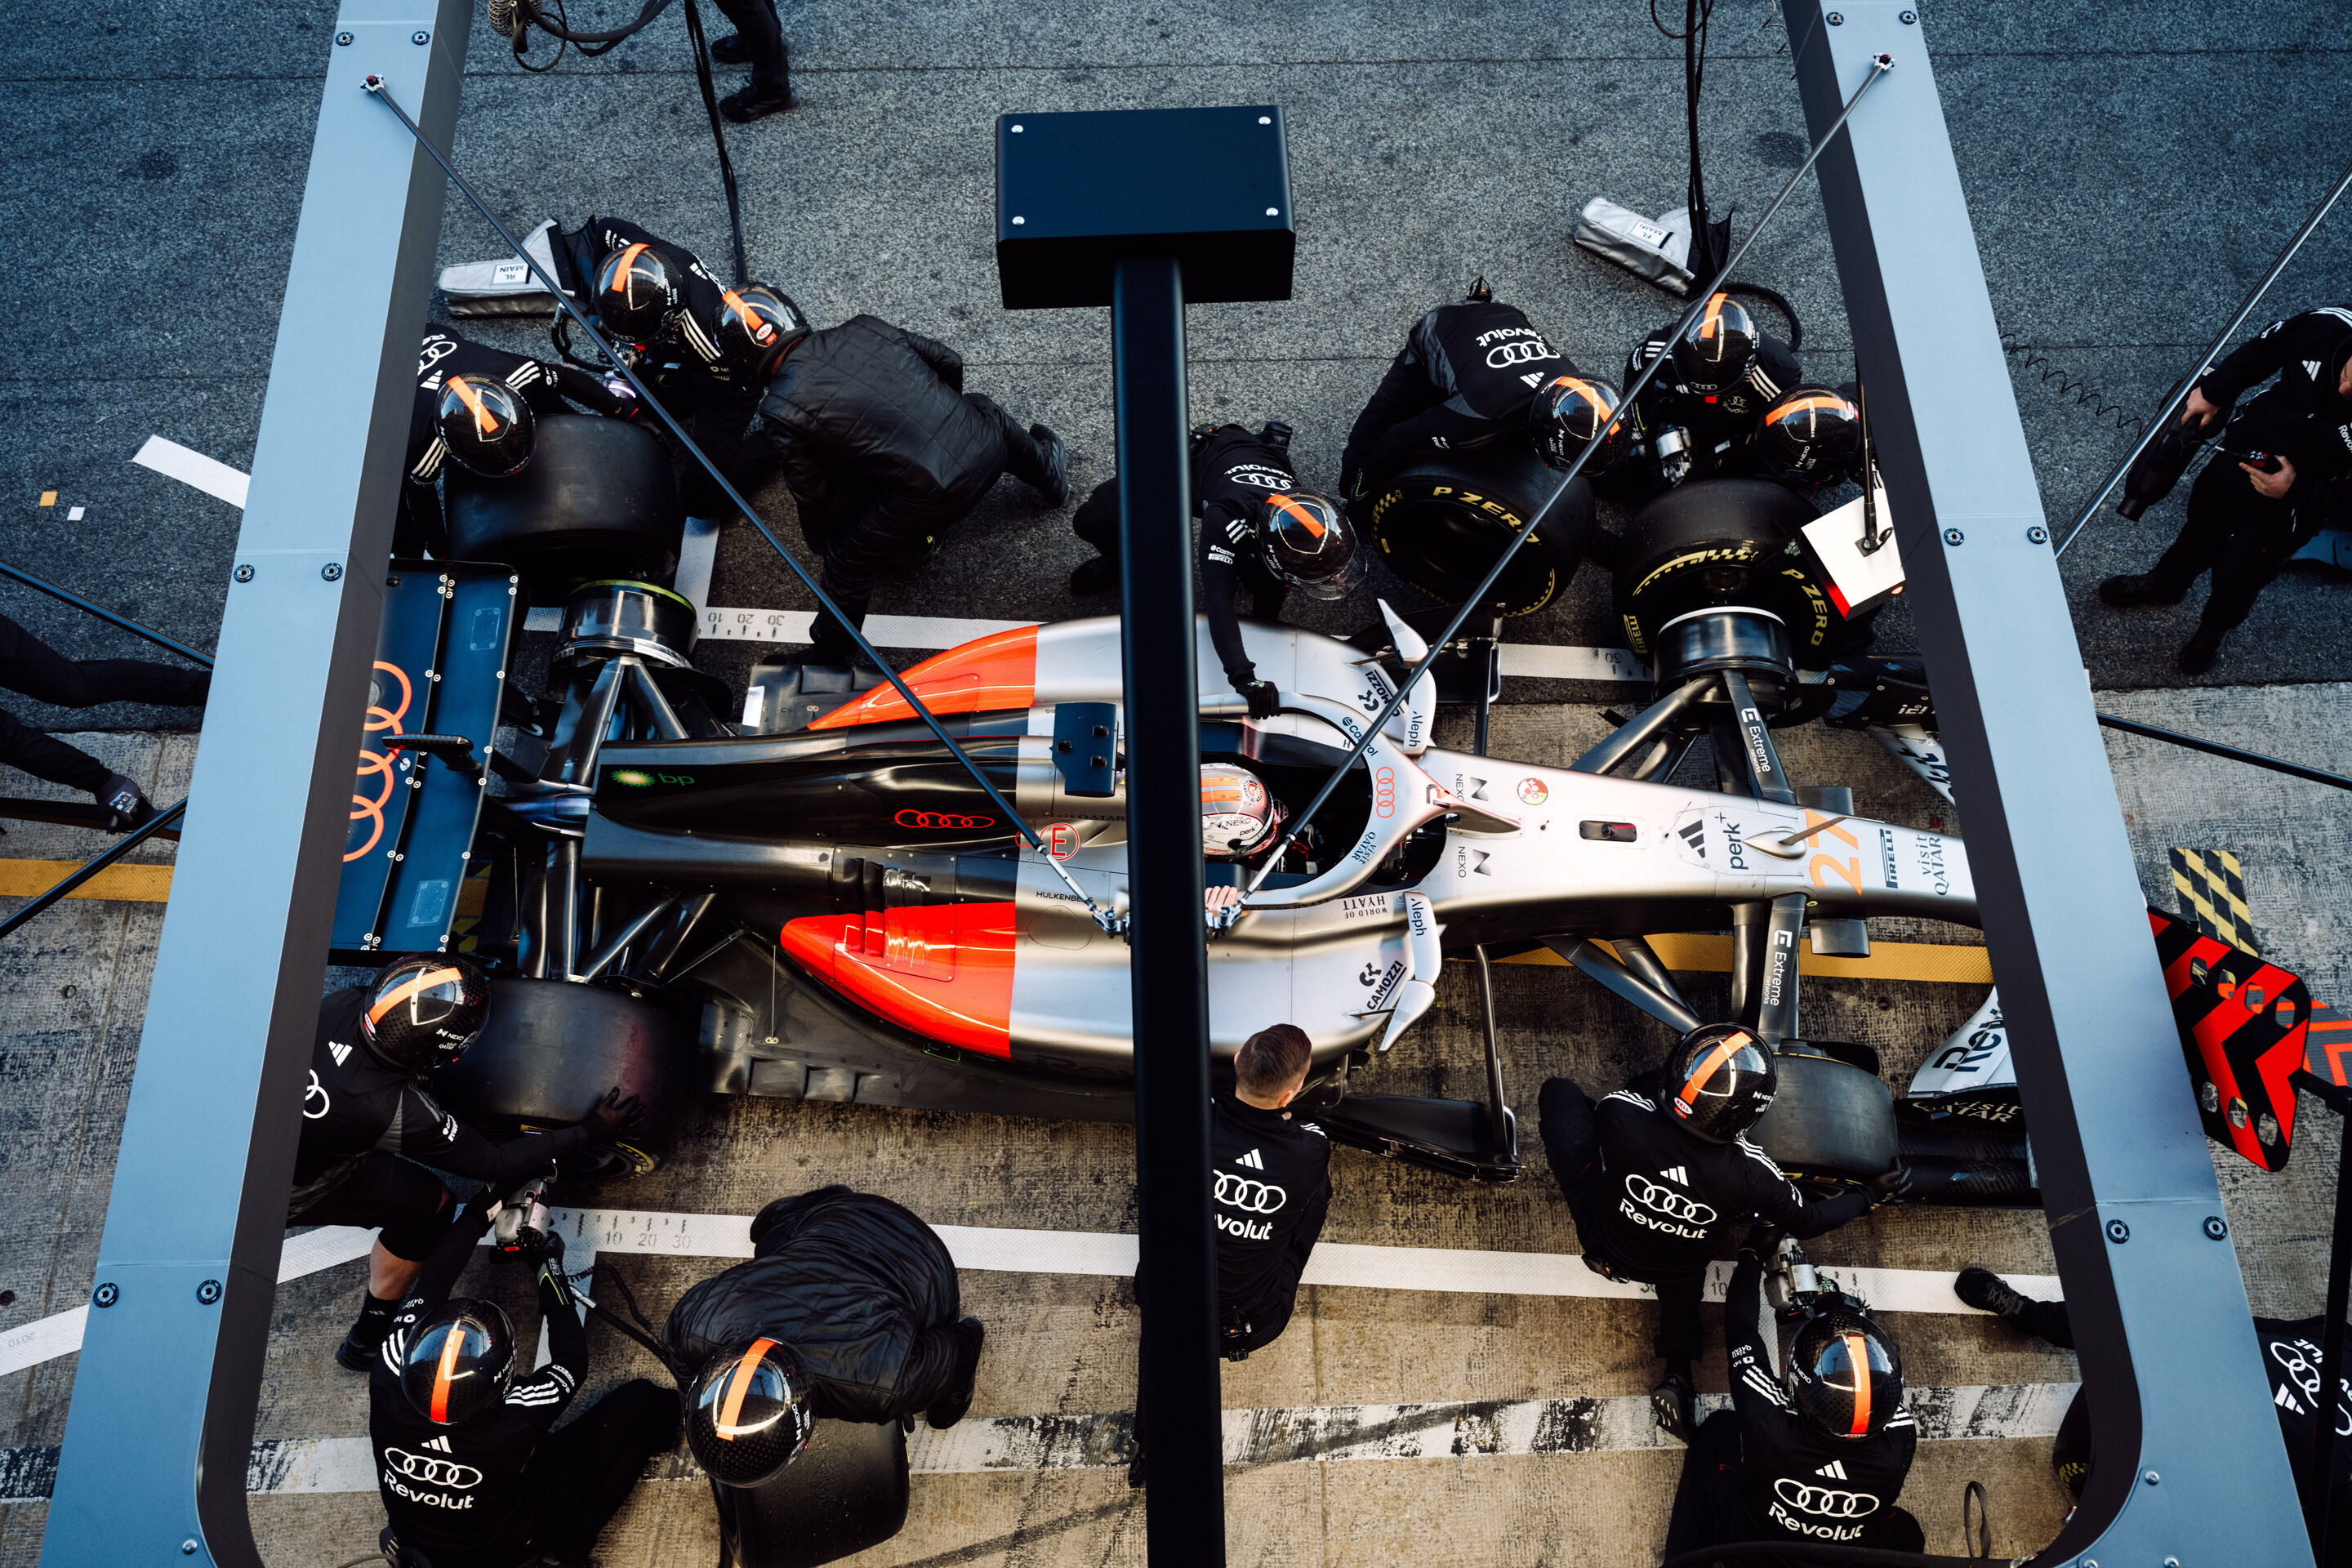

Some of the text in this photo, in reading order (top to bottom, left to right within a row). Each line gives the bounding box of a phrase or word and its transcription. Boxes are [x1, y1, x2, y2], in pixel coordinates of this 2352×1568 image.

[1639, 224, 1663, 236] MAIN
[1800, 445, 1811, 461] NEXO
[1432, 486, 1453, 496] P
[708, 612, 786, 626] 30 20 10
[1781, 568, 1805, 580] P
[1801, 583, 1828, 646] ZERO
[1624, 614, 1648, 654] PIRELLI
[1365, 670, 1401, 717] CMOZZI
[1749, 725, 1771, 772] Extreme
[1749, 748, 1762, 773] networks
[658, 773, 695, 786] bp
[1455, 773, 1464, 801] NEXO
[1226, 817, 1251, 827] NEXO
[1051, 826, 1067, 857] E
[1352, 831, 1376, 861] QATAR
[1359, 844, 1377, 865] visit
[1803, 807, 1862, 896] 27
[1916, 834, 1931, 875] visit
[1458, 846, 1467, 878] NEXO
[1879, 828, 1899, 889] PIRELLI
[1928, 837, 1949, 896] QATAR
[1036, 891, 1094, 903] HULKENBEG
[1343, 895, 1386, 911] HYATT
[1358, 906, 1388, 917] WORLD
[1366, 960, 1404, 1011] CAMOZZI
[1770, 951, 1787, 1006] Extreme
[448, 1032, 465, 1041] NEXO
[1676, 1098, 1690, 1112] BELL
[1953, 1101, 2024, 1115] visit
[1214, 1213, 1273, 1240] volut
[1619, 1198, 1708, 1239] Revolut
[606, 1231, 692, 1249] 10 20 30
[1712, 1281, 1728, 1296] 10
[1797, 1367, 1812, 1384] NEXO
[791, 1403, 801, 1428] NEXO
[383, 1469, 474, 1509] Revolut
[1768, 1501, 1864, 1541] Revolut
